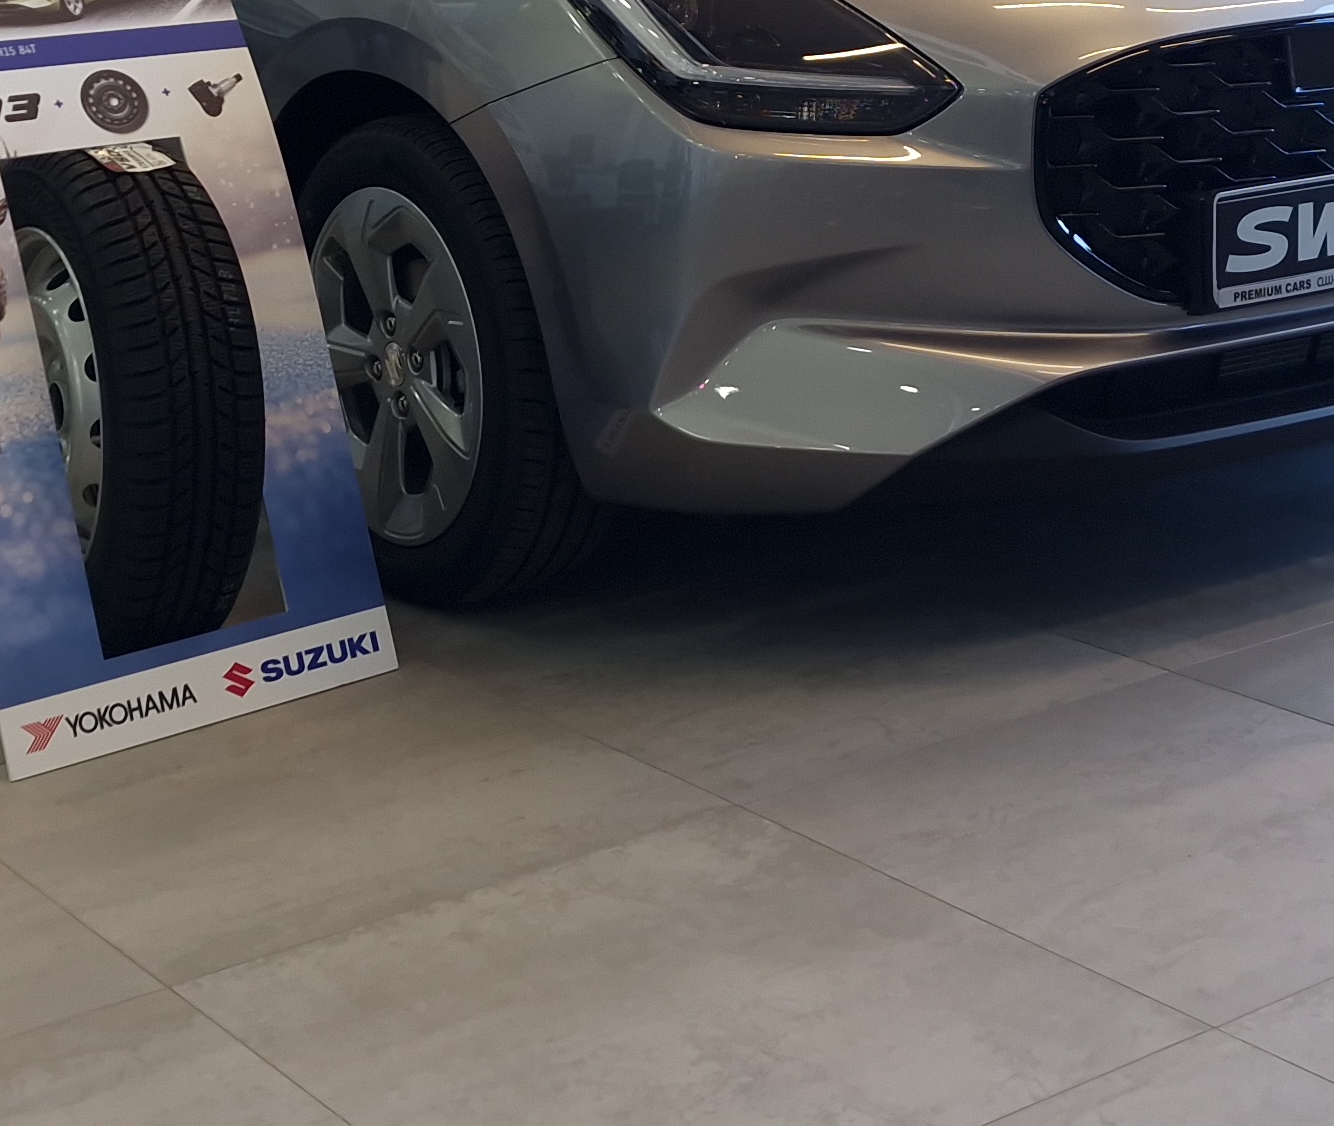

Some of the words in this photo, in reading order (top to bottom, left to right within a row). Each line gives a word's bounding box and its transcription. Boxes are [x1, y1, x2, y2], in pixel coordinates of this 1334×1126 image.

[1233, 284, 1283, 303] PREMIUM
[1285, 278, 1312, 294] CARS
[260, 630, 381, 683] SUZUKI
[65, 682, 198, 738] YOKOHAMA
